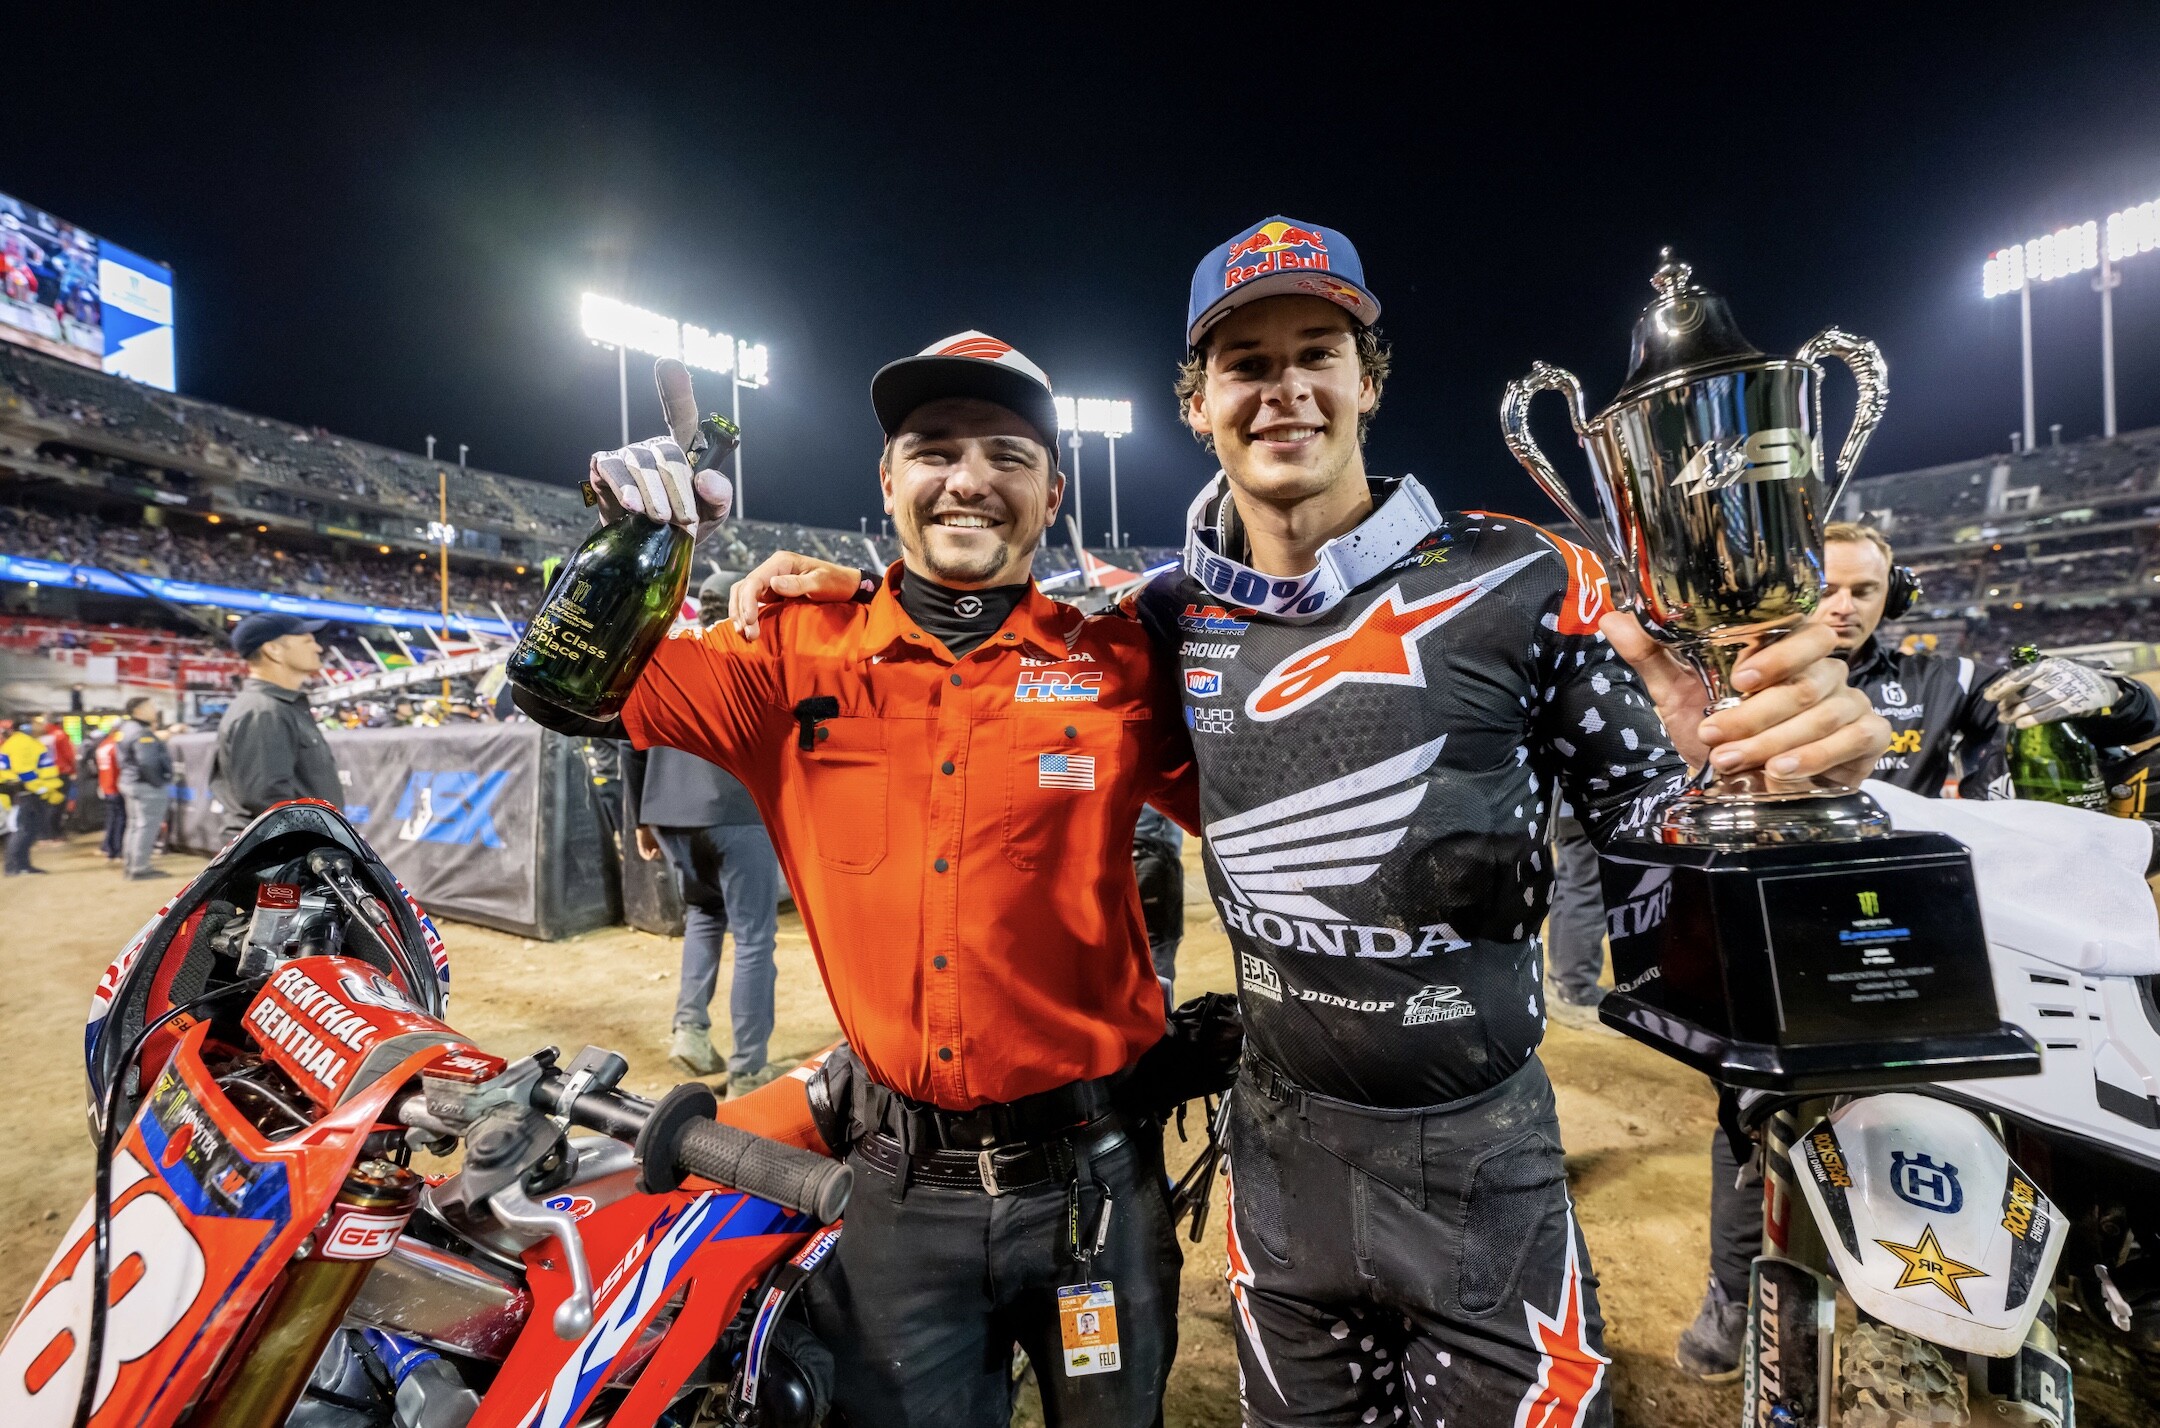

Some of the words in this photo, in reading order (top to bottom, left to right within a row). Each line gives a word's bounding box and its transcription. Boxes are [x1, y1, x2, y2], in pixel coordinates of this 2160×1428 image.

[1225, 251, 1276, 290] Red
[1278, 251, 1330, 272] Bull
[1194, 543, 1326, 614] 100%
[1177, 604, 1259, 631] HRC
[1205, 628, 1246, 636] RACING
[537, 632, 580, 661] Place
[561, 631, 608, 660] Class
[1179, 641, 1241, 659] SHOWA
[1015, 671, 1103, 697] HRC
[1188, 674, 1216, 692] 100%
[1056, 695, 1099, 703] RACING
[1195, 707, 1234, 721] QUAD
[1195, 721, 1235, 735] LOCK
[1218, 896, 1472, 959] HONDA
[272, 967, 379, 1053] RENTHAL
[1300, 990, 1395, 1012] DUNLOP
[1403, 1005, 1476, 1026] RENTHAL
[250, 996, 348, 1090] RENTHAL
[1813, 1133, 1853, 1187] ROCKSTAR
[2002, 1177, 2034, 1241] ROCKSTAR
[339, 1226, 401, 1246] GET
[1100, 1352, 1116, 1367] FELD
